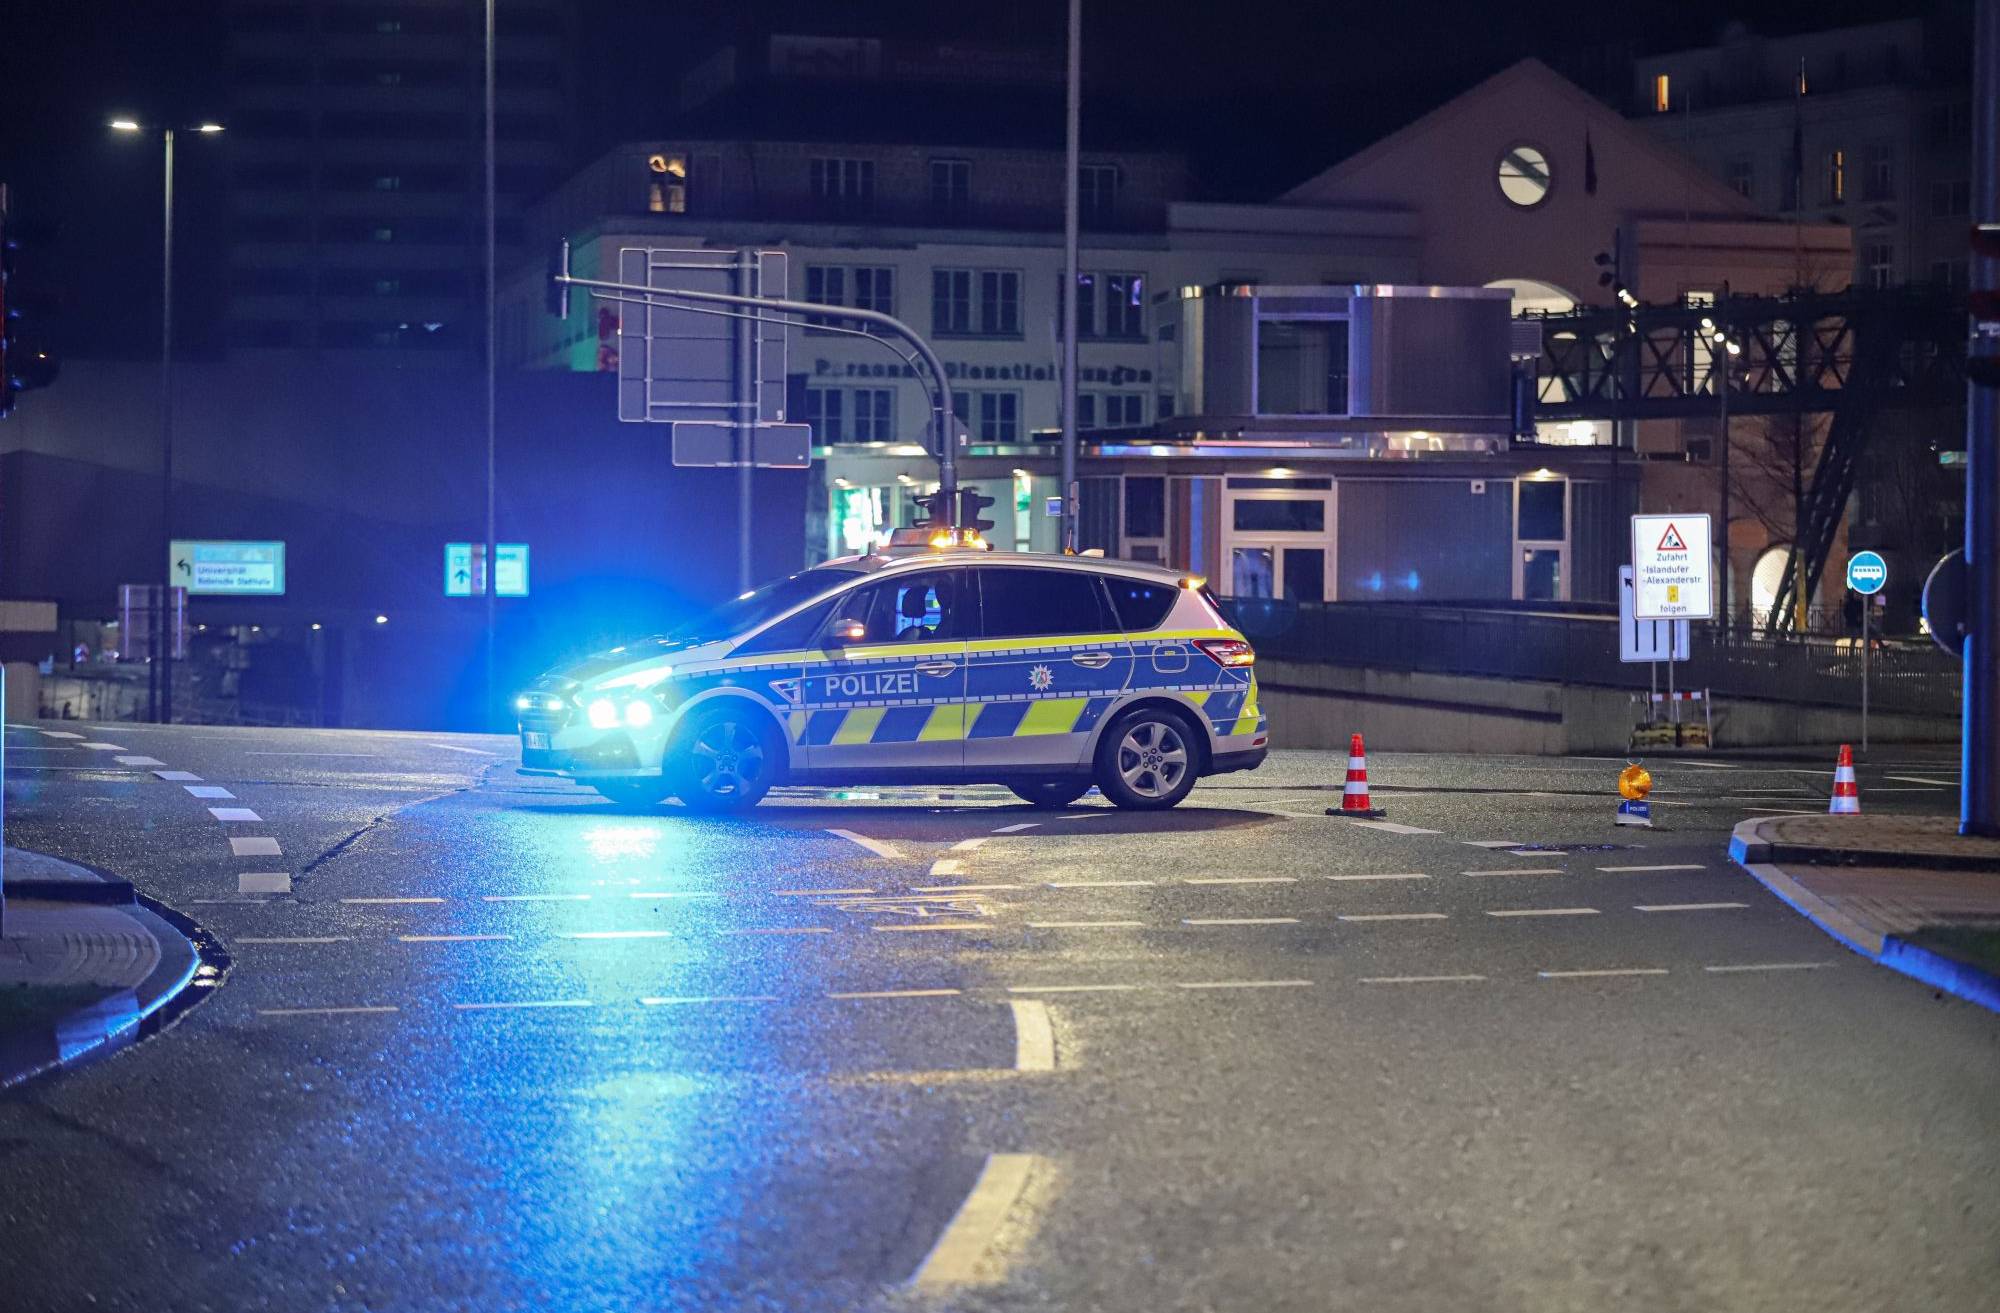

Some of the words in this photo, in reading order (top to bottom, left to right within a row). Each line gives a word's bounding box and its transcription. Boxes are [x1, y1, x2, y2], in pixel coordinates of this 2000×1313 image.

[944, 361, 1152, 386] Dienstleiungen
[1656, 553, 1688, 562] Zufahrt
[1660, 604, 1687, 614] folgen
[825, 673, 919, 697] POLIZEI
